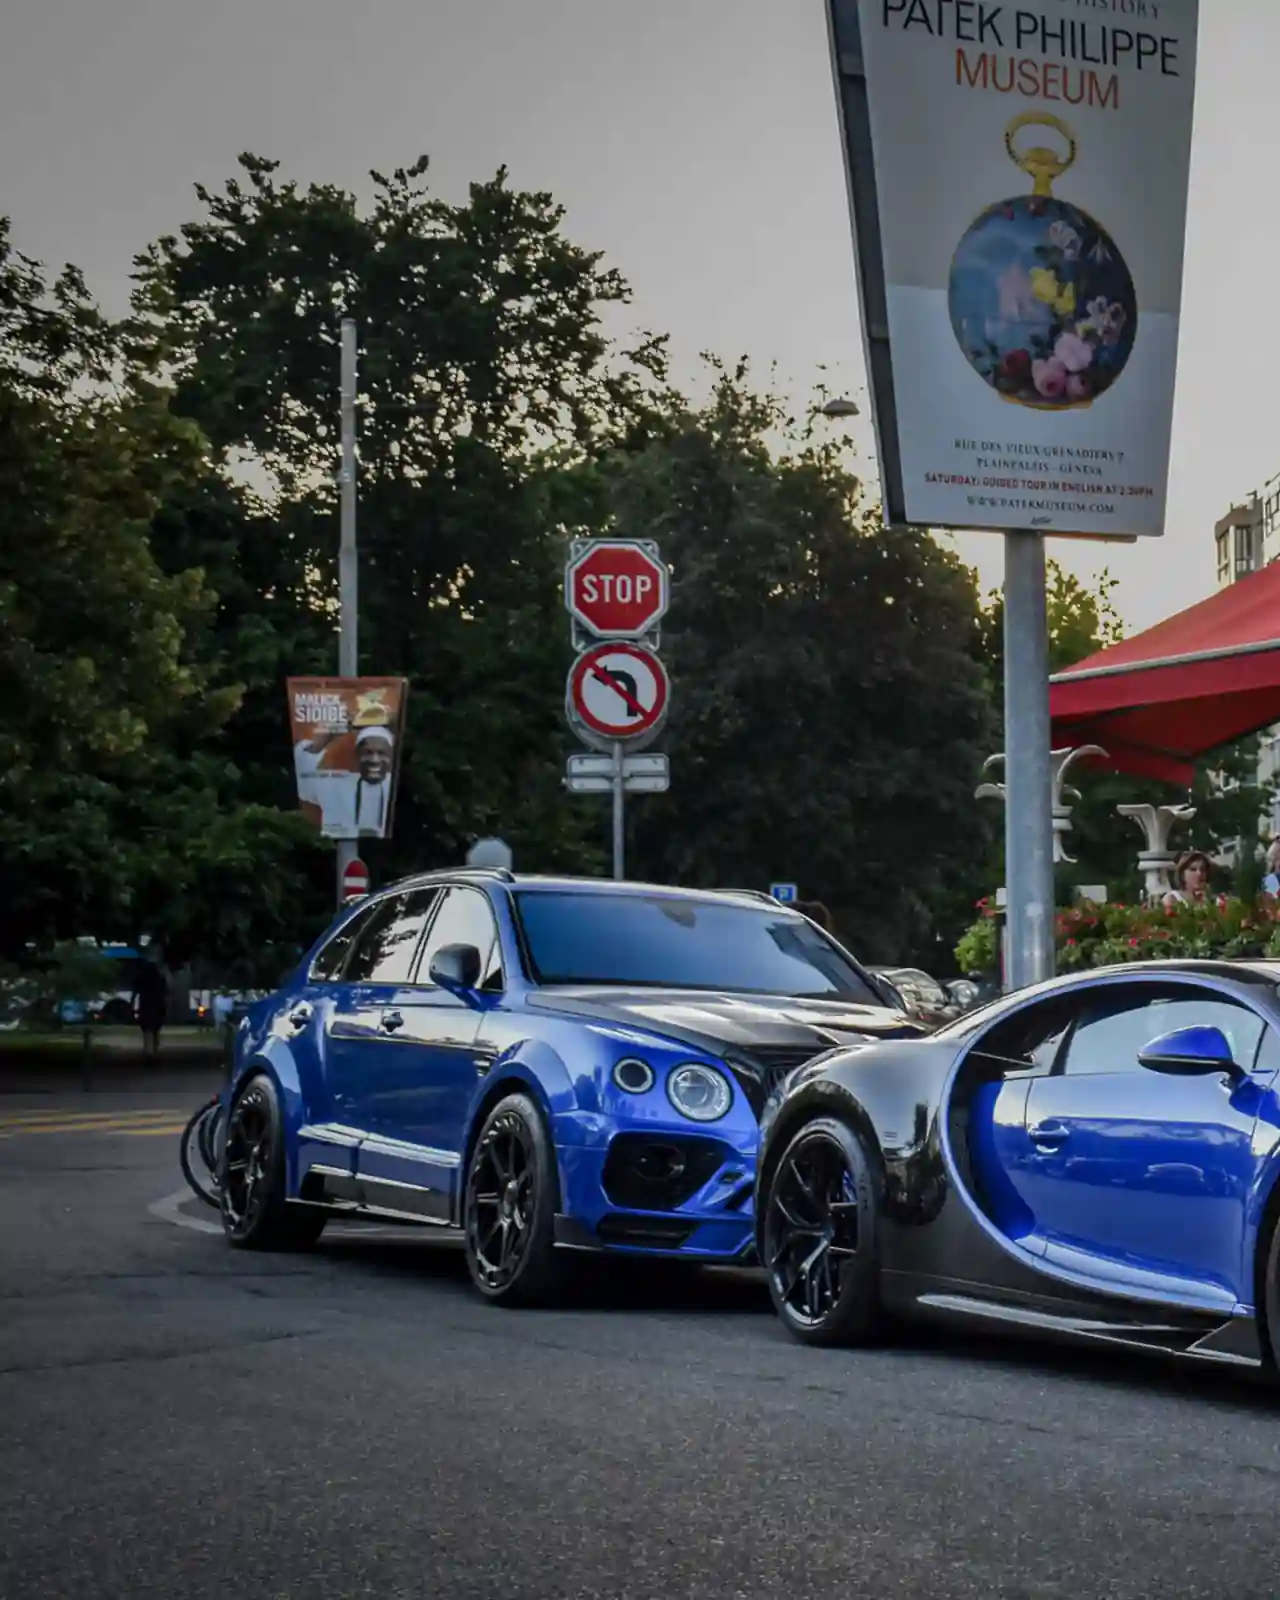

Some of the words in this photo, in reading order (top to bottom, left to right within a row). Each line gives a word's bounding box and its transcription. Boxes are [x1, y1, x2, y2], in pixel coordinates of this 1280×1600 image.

[883, 0, 1003, 47] PATEK
[1016, 11, 1180, 77] PHILIPPE
[956, 48, 1119, 110] MUSEUM
[954, 438, 977, 451] RUE
[981, 440, 1002, 453] DES
[982, 476, 1019, 489] GUIDED
[1021, 478, 1046, 491] TOUR
[1062, 481, 1102, 494] ENGLISH
[582, 574, 652, 604] STOP
